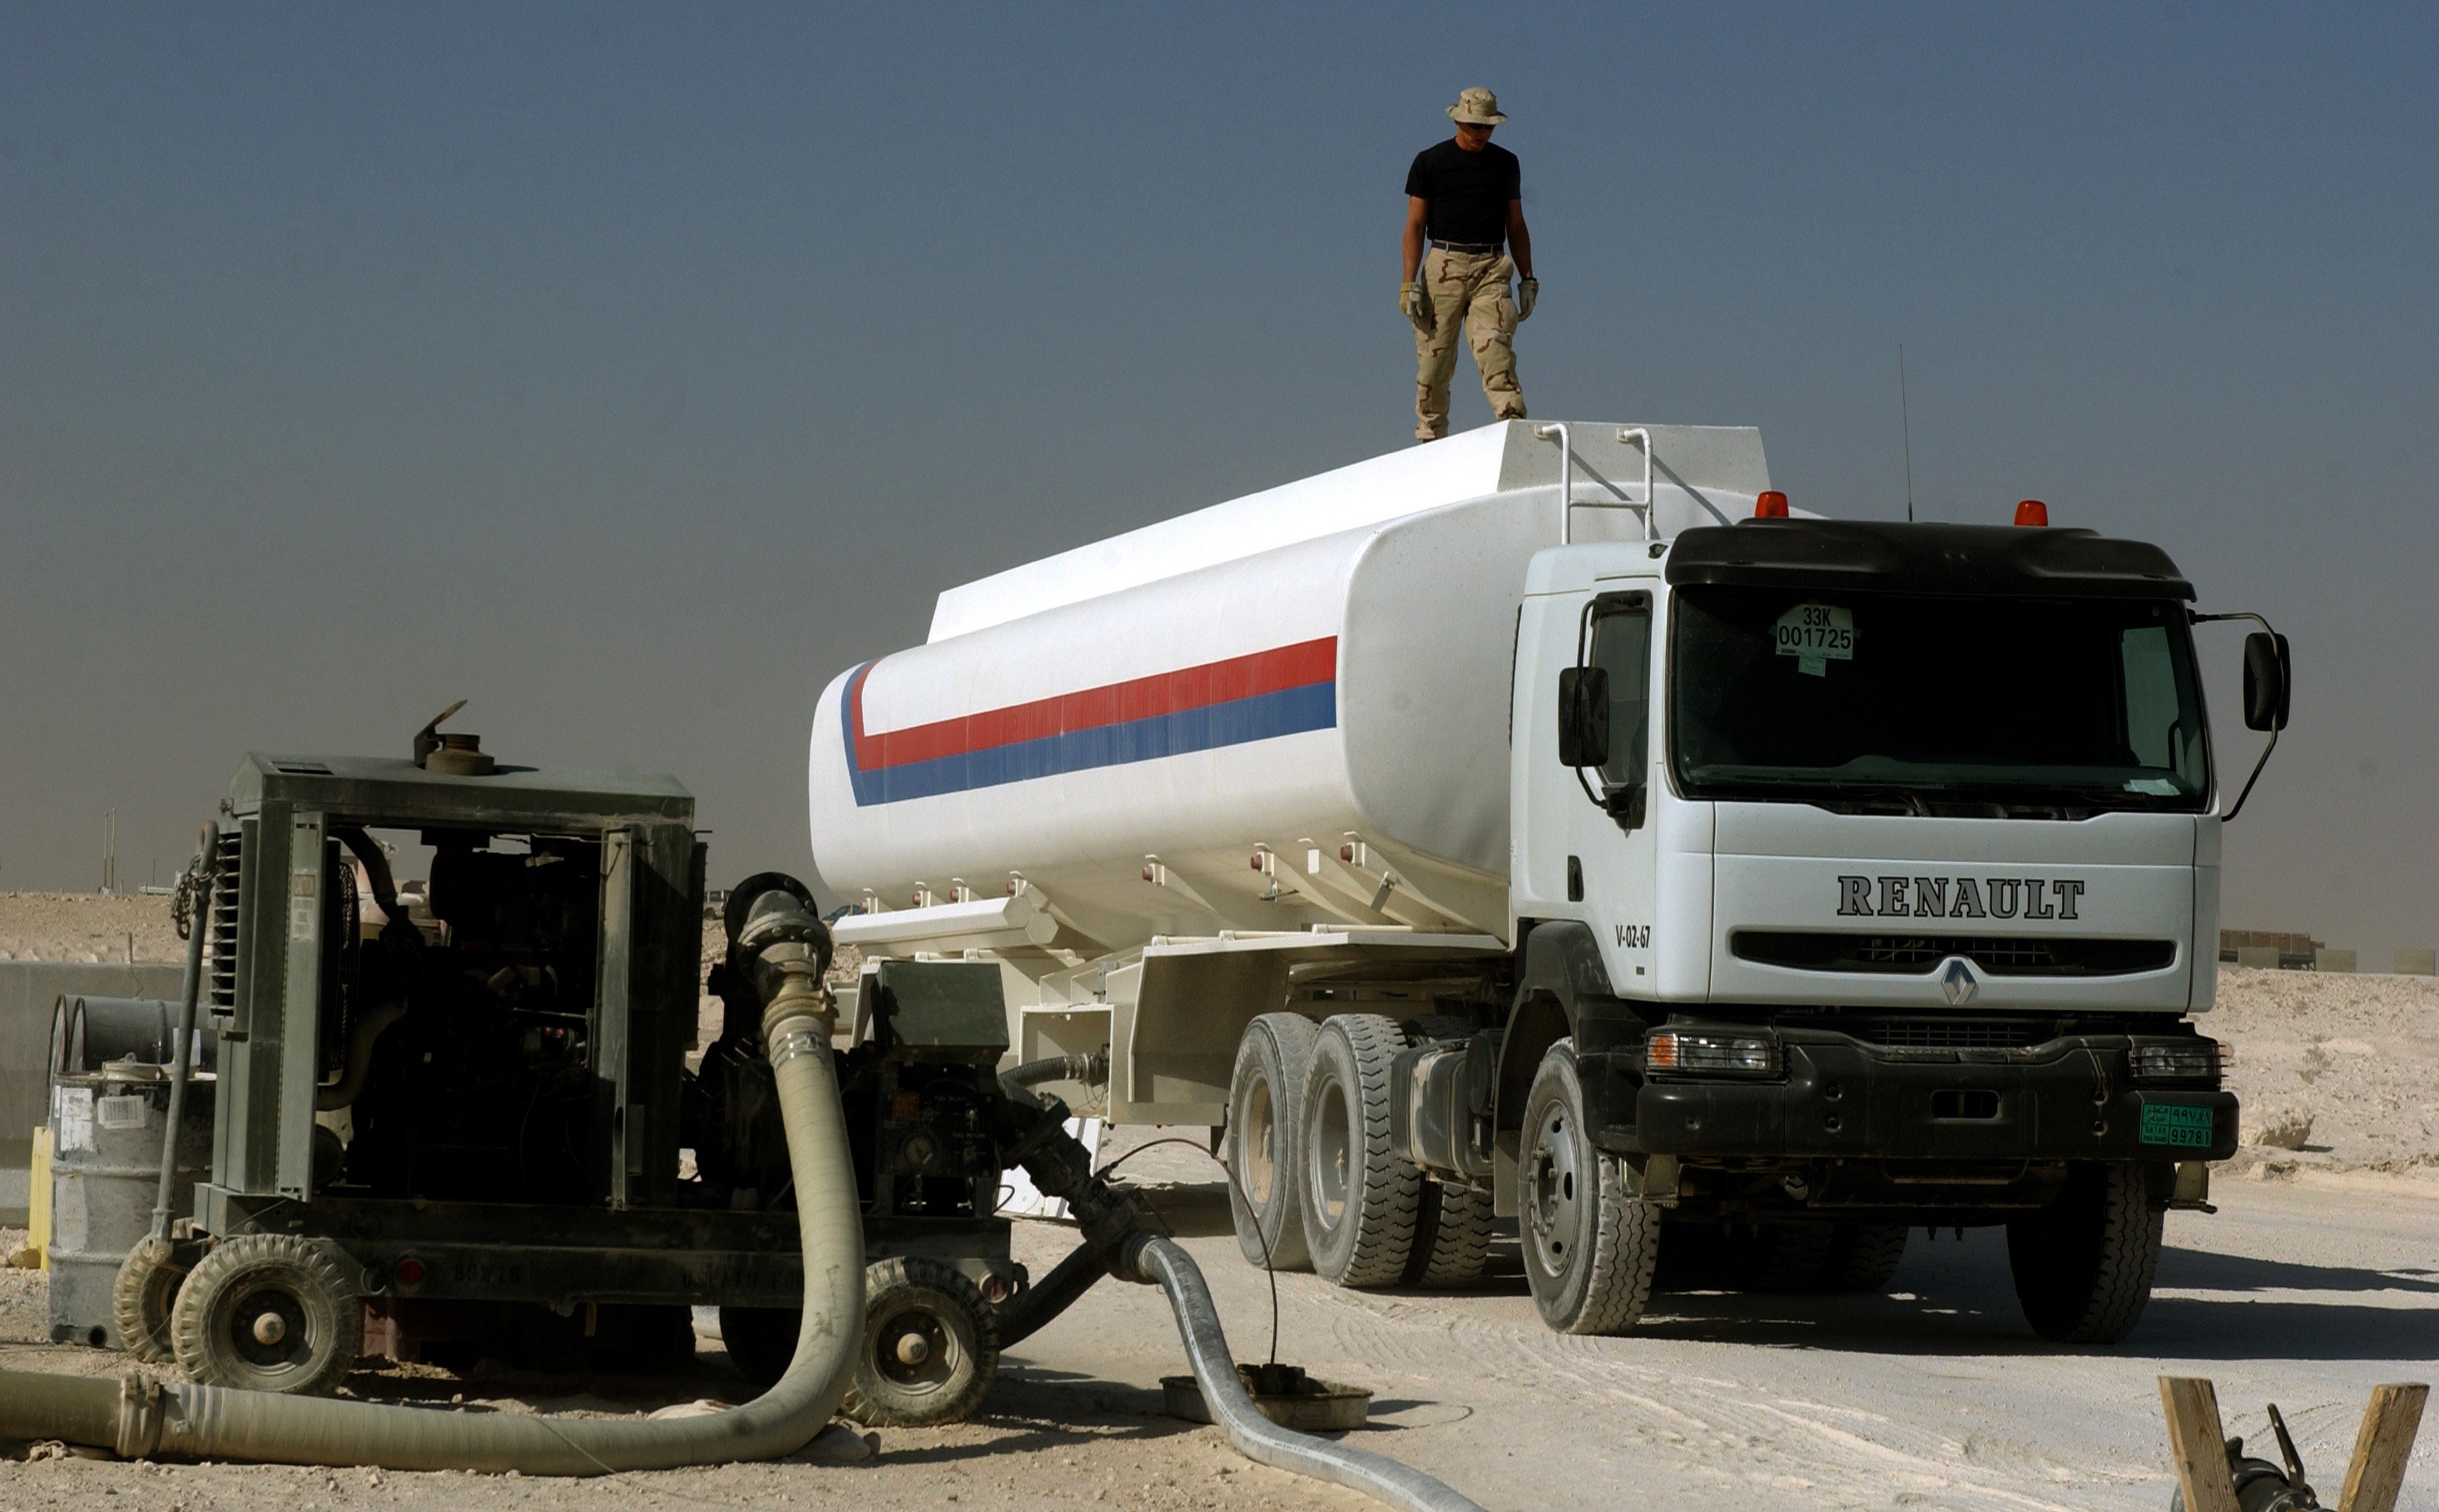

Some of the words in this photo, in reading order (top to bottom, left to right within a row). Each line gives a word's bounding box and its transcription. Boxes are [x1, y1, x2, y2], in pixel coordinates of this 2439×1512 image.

[1803, 607, 1831, 627] 33K
[1778, 625, 1852, 649] 001725
[1837, 875, 2085, 920] RENAULT
[1615, 925, 1650, 949] V-02-67
[2171, 1128, 2208, 1144] 99781
